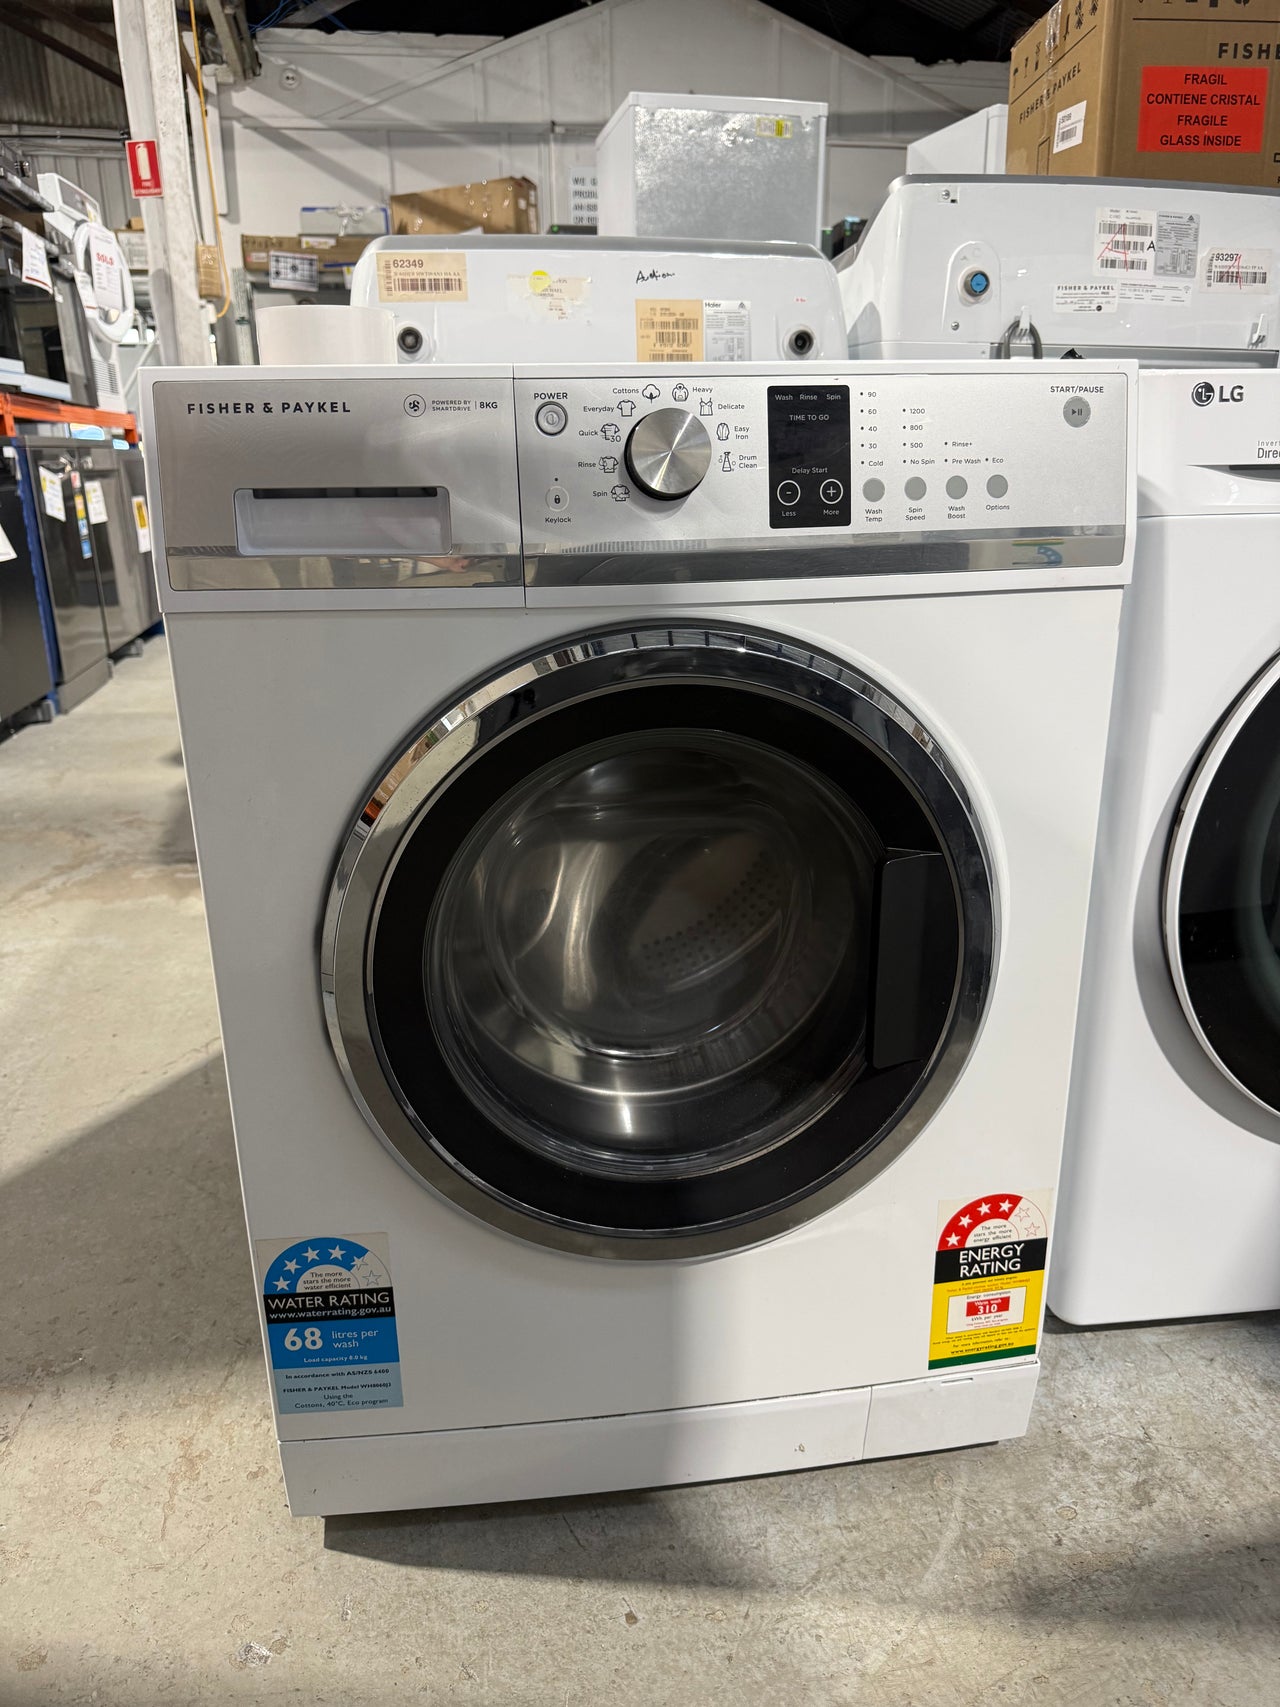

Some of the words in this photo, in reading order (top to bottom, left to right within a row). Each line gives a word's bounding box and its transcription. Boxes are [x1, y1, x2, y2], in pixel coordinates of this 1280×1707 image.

[1184, 73, 1228, 86] FRAGIL
[1019, 94, 1044, 124] FISHER
[1052, 61, 1082, 95] PAYKEL
[1146, 93, 1207, 106] CONTIENE
[1210, 94, 1261, 107] CRISTAL
[1177, 114, 1229, 127] FRAGILE
[1160, 134, 1201, 147] GLASS
[1203, 134, 1242, 147] INSIDE
[1147, 241, 1156, 252] A
[392, 259, 424, 269] 62349
[1050, 385, 1105, 394] START/PAUSE
[1218, 384, 1245, 403] LG
[533, 392, 568, 400] POWER
[774, 393, 793, 401] Wash
[187, 403, 255, 415] FISHER
[263, 402, 273, 413] &
[281, 401, 351, 413] PAYKEL
[479, 401, 498, 409] 8KG
[583, 405, 615, 413] Everyday
[909, 407, 926, 415] 1200
[734, 425, 750, 433] Easy
[610, 435, 622, 443] 30
[910, 441, 924, 449] 500
[951, 440, 973, 448] Rinse+
[1257, 447, 1280, 459] Dire
[964, 457, 982, 465] Wash
[791, 466, 811, 475] Delay
[811, 466, 828, 474] Start
[592, 490, 608, 498] Spin
[823, 508, 840, 516] More
[908, 507, 923, 515] Spin
[985, 504, 1010, 512] Options
[545, 516, 572, 524] Keylock
[865, 515, 883, 523] Temp
[905, 513, 926, 522] Speed
[959, 1243, 1025, 1264] ENERGY
[960, 1258, 1021, 1279] RATING
[267, 1296, 326, 1311] WATER
[329, 1291, 390, 1306] RATING
[269, 1305, 392, 1320] www.waterrating.gov.au
[977, 1304, 998, 1315] 310
[331, 1331, 358, 1339] litres
[361, 1330, 379, 1339] per
[284, 1327, 323, 1352] 68
[332, 1339, 359, 1349] wash
[293, 1371, 330, 1379] accordance
